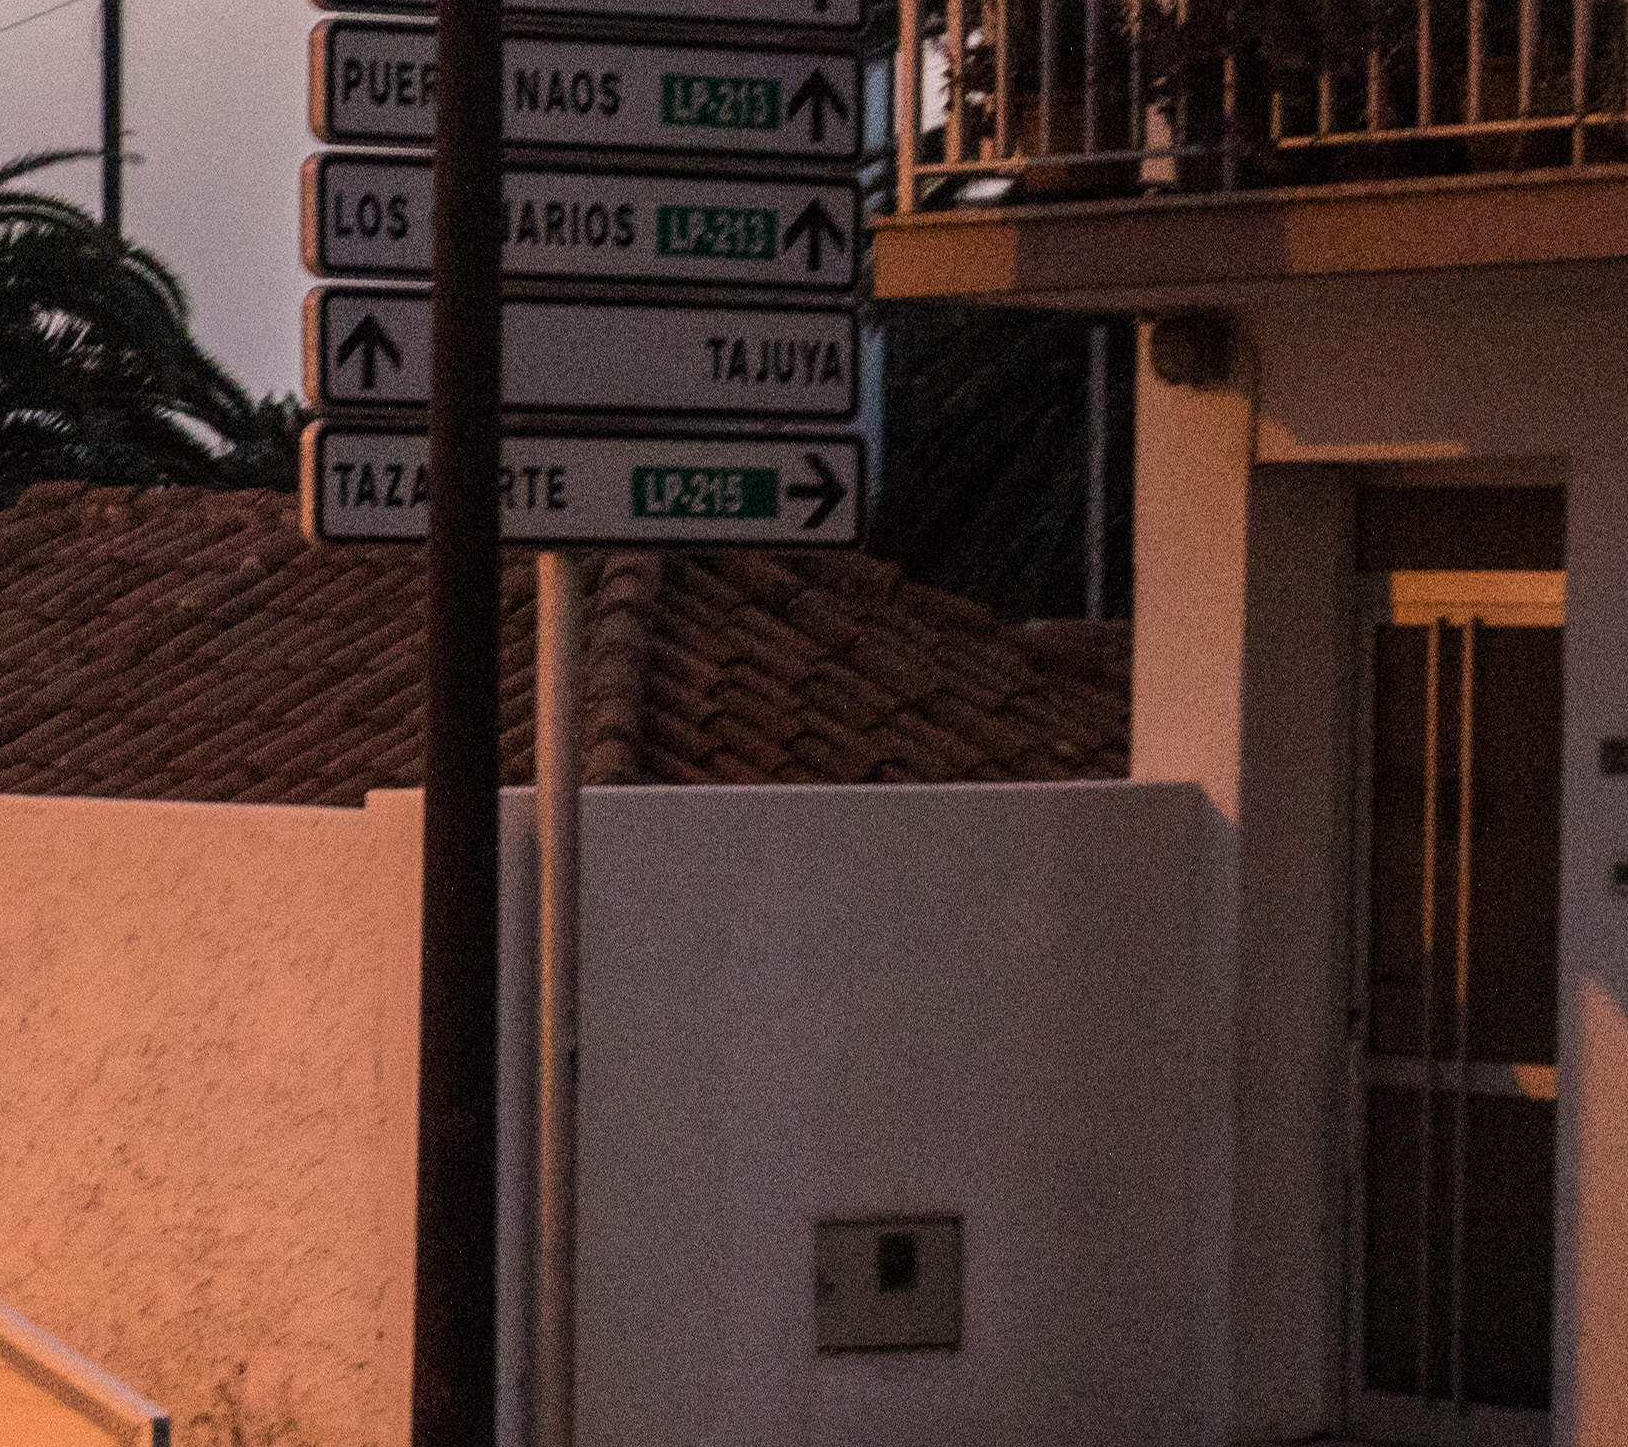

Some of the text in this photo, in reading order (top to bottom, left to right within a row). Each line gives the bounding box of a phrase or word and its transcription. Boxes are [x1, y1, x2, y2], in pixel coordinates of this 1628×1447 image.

[341, 58, 771, 126] PUER NAOS LP-213
[334, 193, 410, 240] LOS
[667, 211, 767, 258] LP-213
[705, 337, 844, 385] TAJUYA
[333, 462, 746, 515] TAZARTE LP-215
